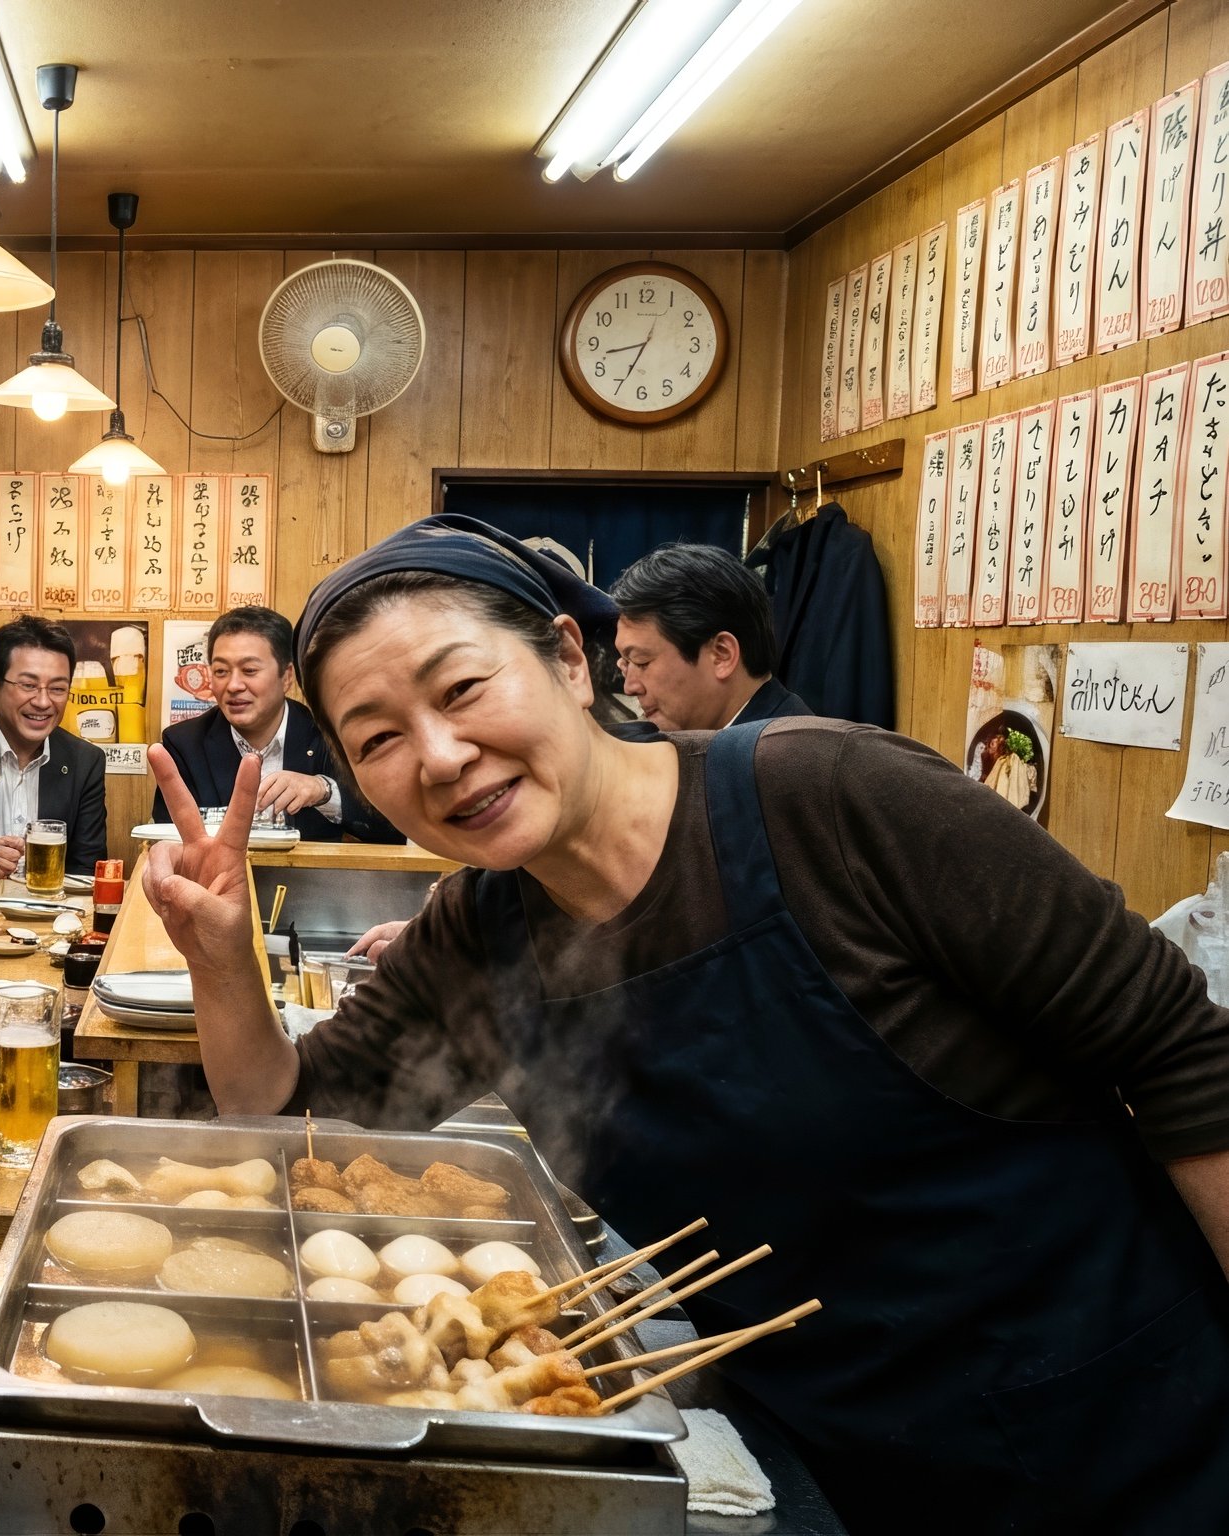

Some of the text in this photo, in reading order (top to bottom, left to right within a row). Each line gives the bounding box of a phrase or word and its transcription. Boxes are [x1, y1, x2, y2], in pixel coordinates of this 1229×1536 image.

[615, 292, 628, 309] 11
[639, 289, 656, 304] 12
[596, 311, 612, 328] 10
[683, 310, 694, 328] 2
[588, 336, 600, 351] 9
[689, 336, 701, 353] 3
[594, 361, 606, 377] 8
[613, 378, 625, 396] 7
[636, 385, 648, 400] 6
[662, 379, 673, 397] 5
